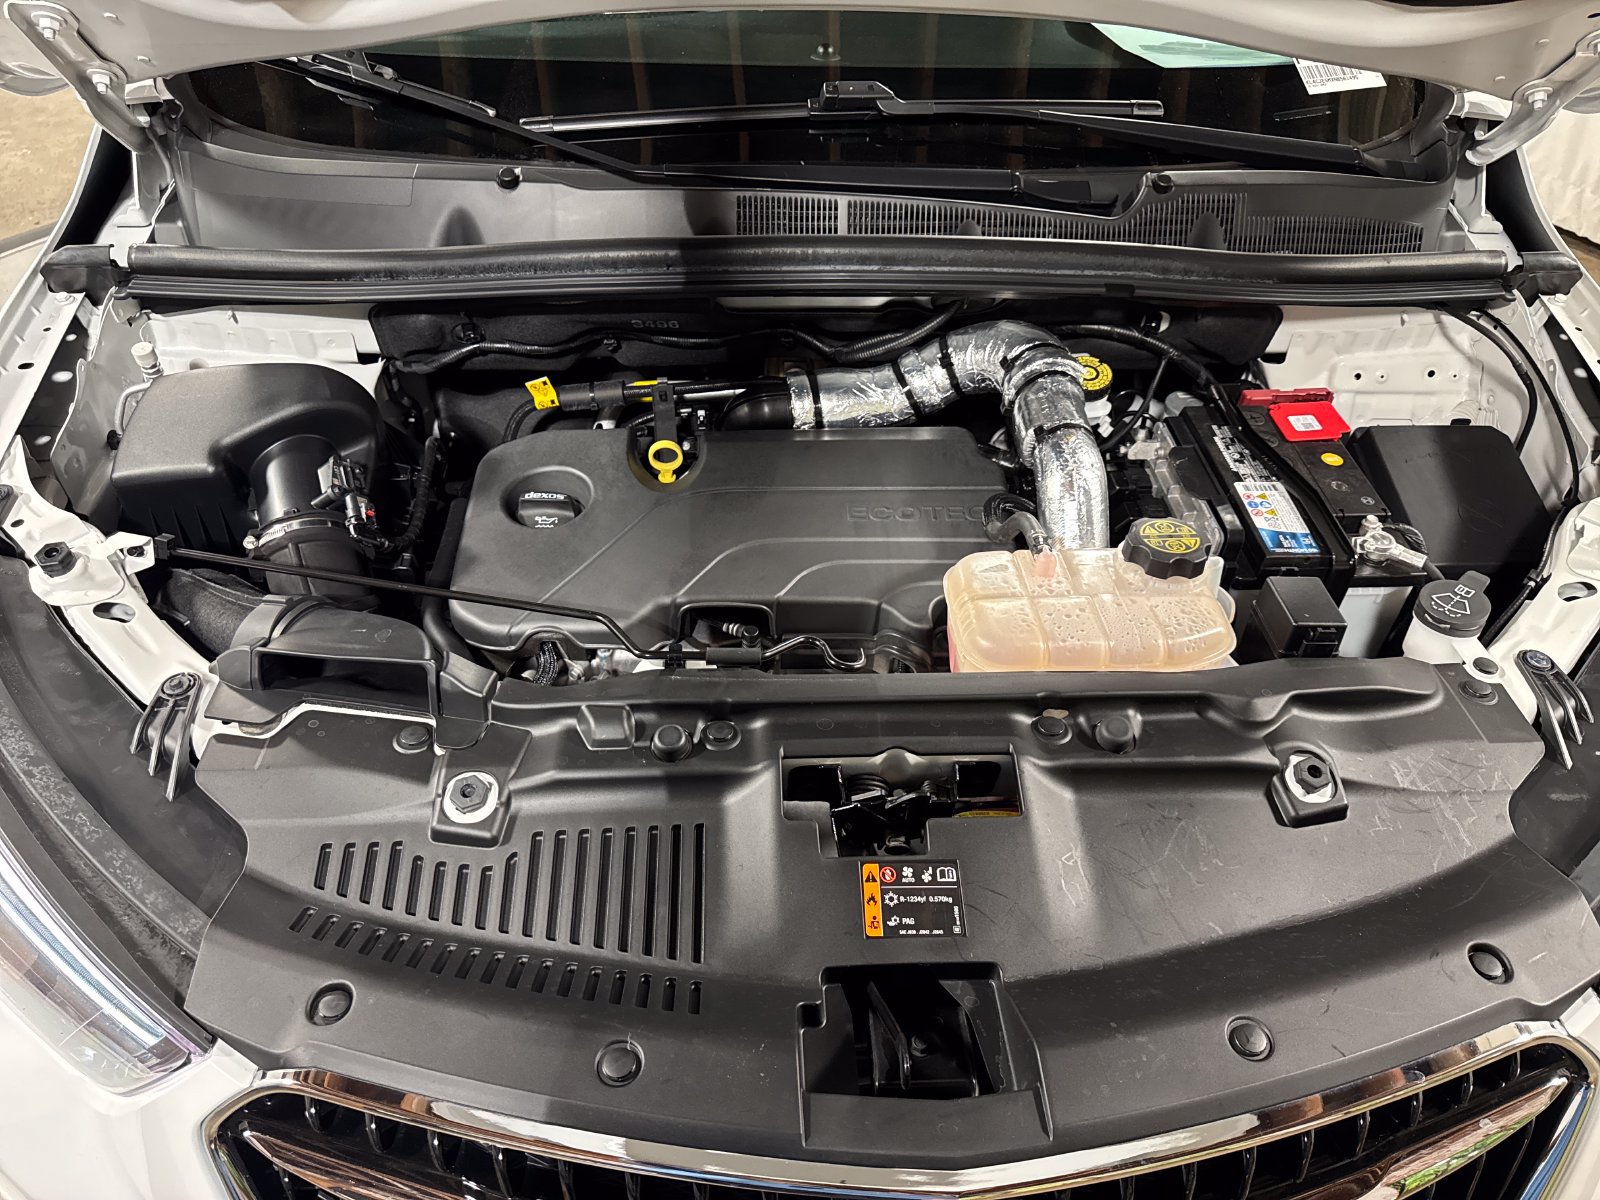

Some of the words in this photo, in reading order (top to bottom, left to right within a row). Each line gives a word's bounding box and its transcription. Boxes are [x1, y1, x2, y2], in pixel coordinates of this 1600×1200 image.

[524, 491, 567, 500] dexos
[899, 896, 927, 904] R-1234yf
[928, 895, 953, 904] 0.570kg
[902, 917, 915, 925] PAG
